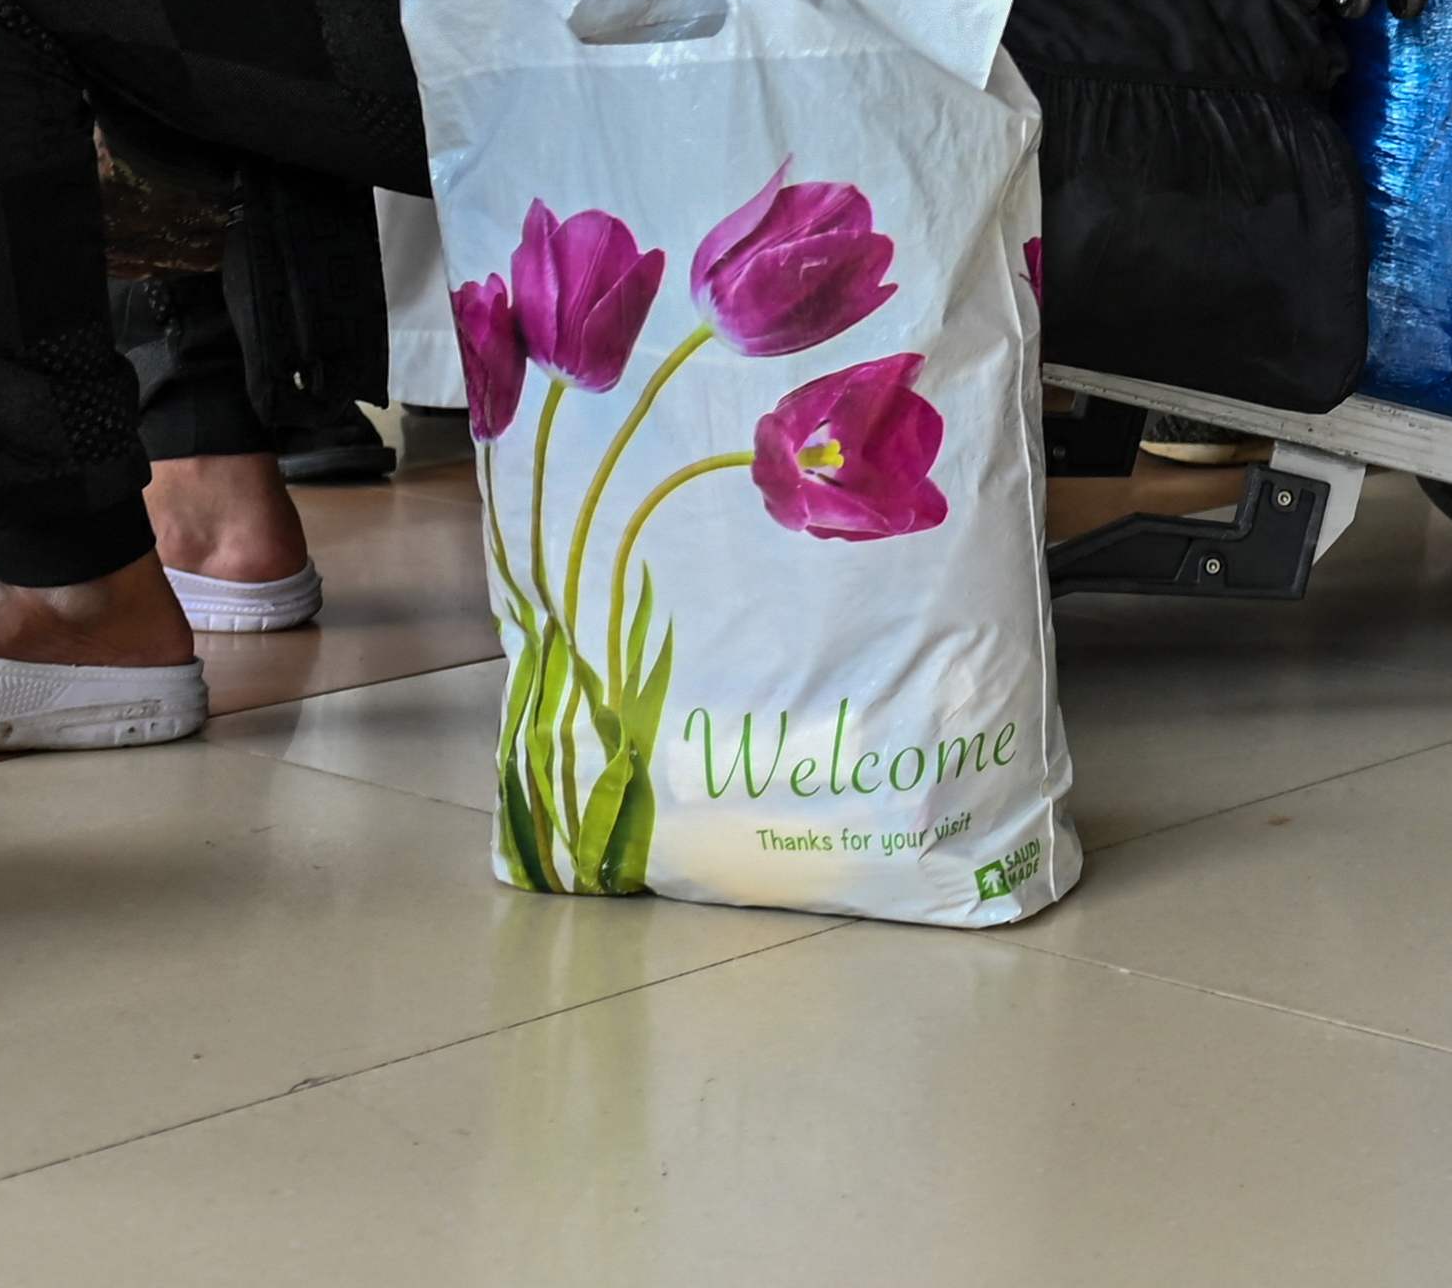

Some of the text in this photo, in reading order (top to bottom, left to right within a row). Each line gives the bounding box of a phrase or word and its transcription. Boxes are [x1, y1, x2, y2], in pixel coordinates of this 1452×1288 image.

[684, 697, 1017, 800] Welcome
[756, 812, 972, 856] Thanks for your visit
[1005, 838, 1041, 871] SAUDI
[1008, 857, 1040, 888] MADE
